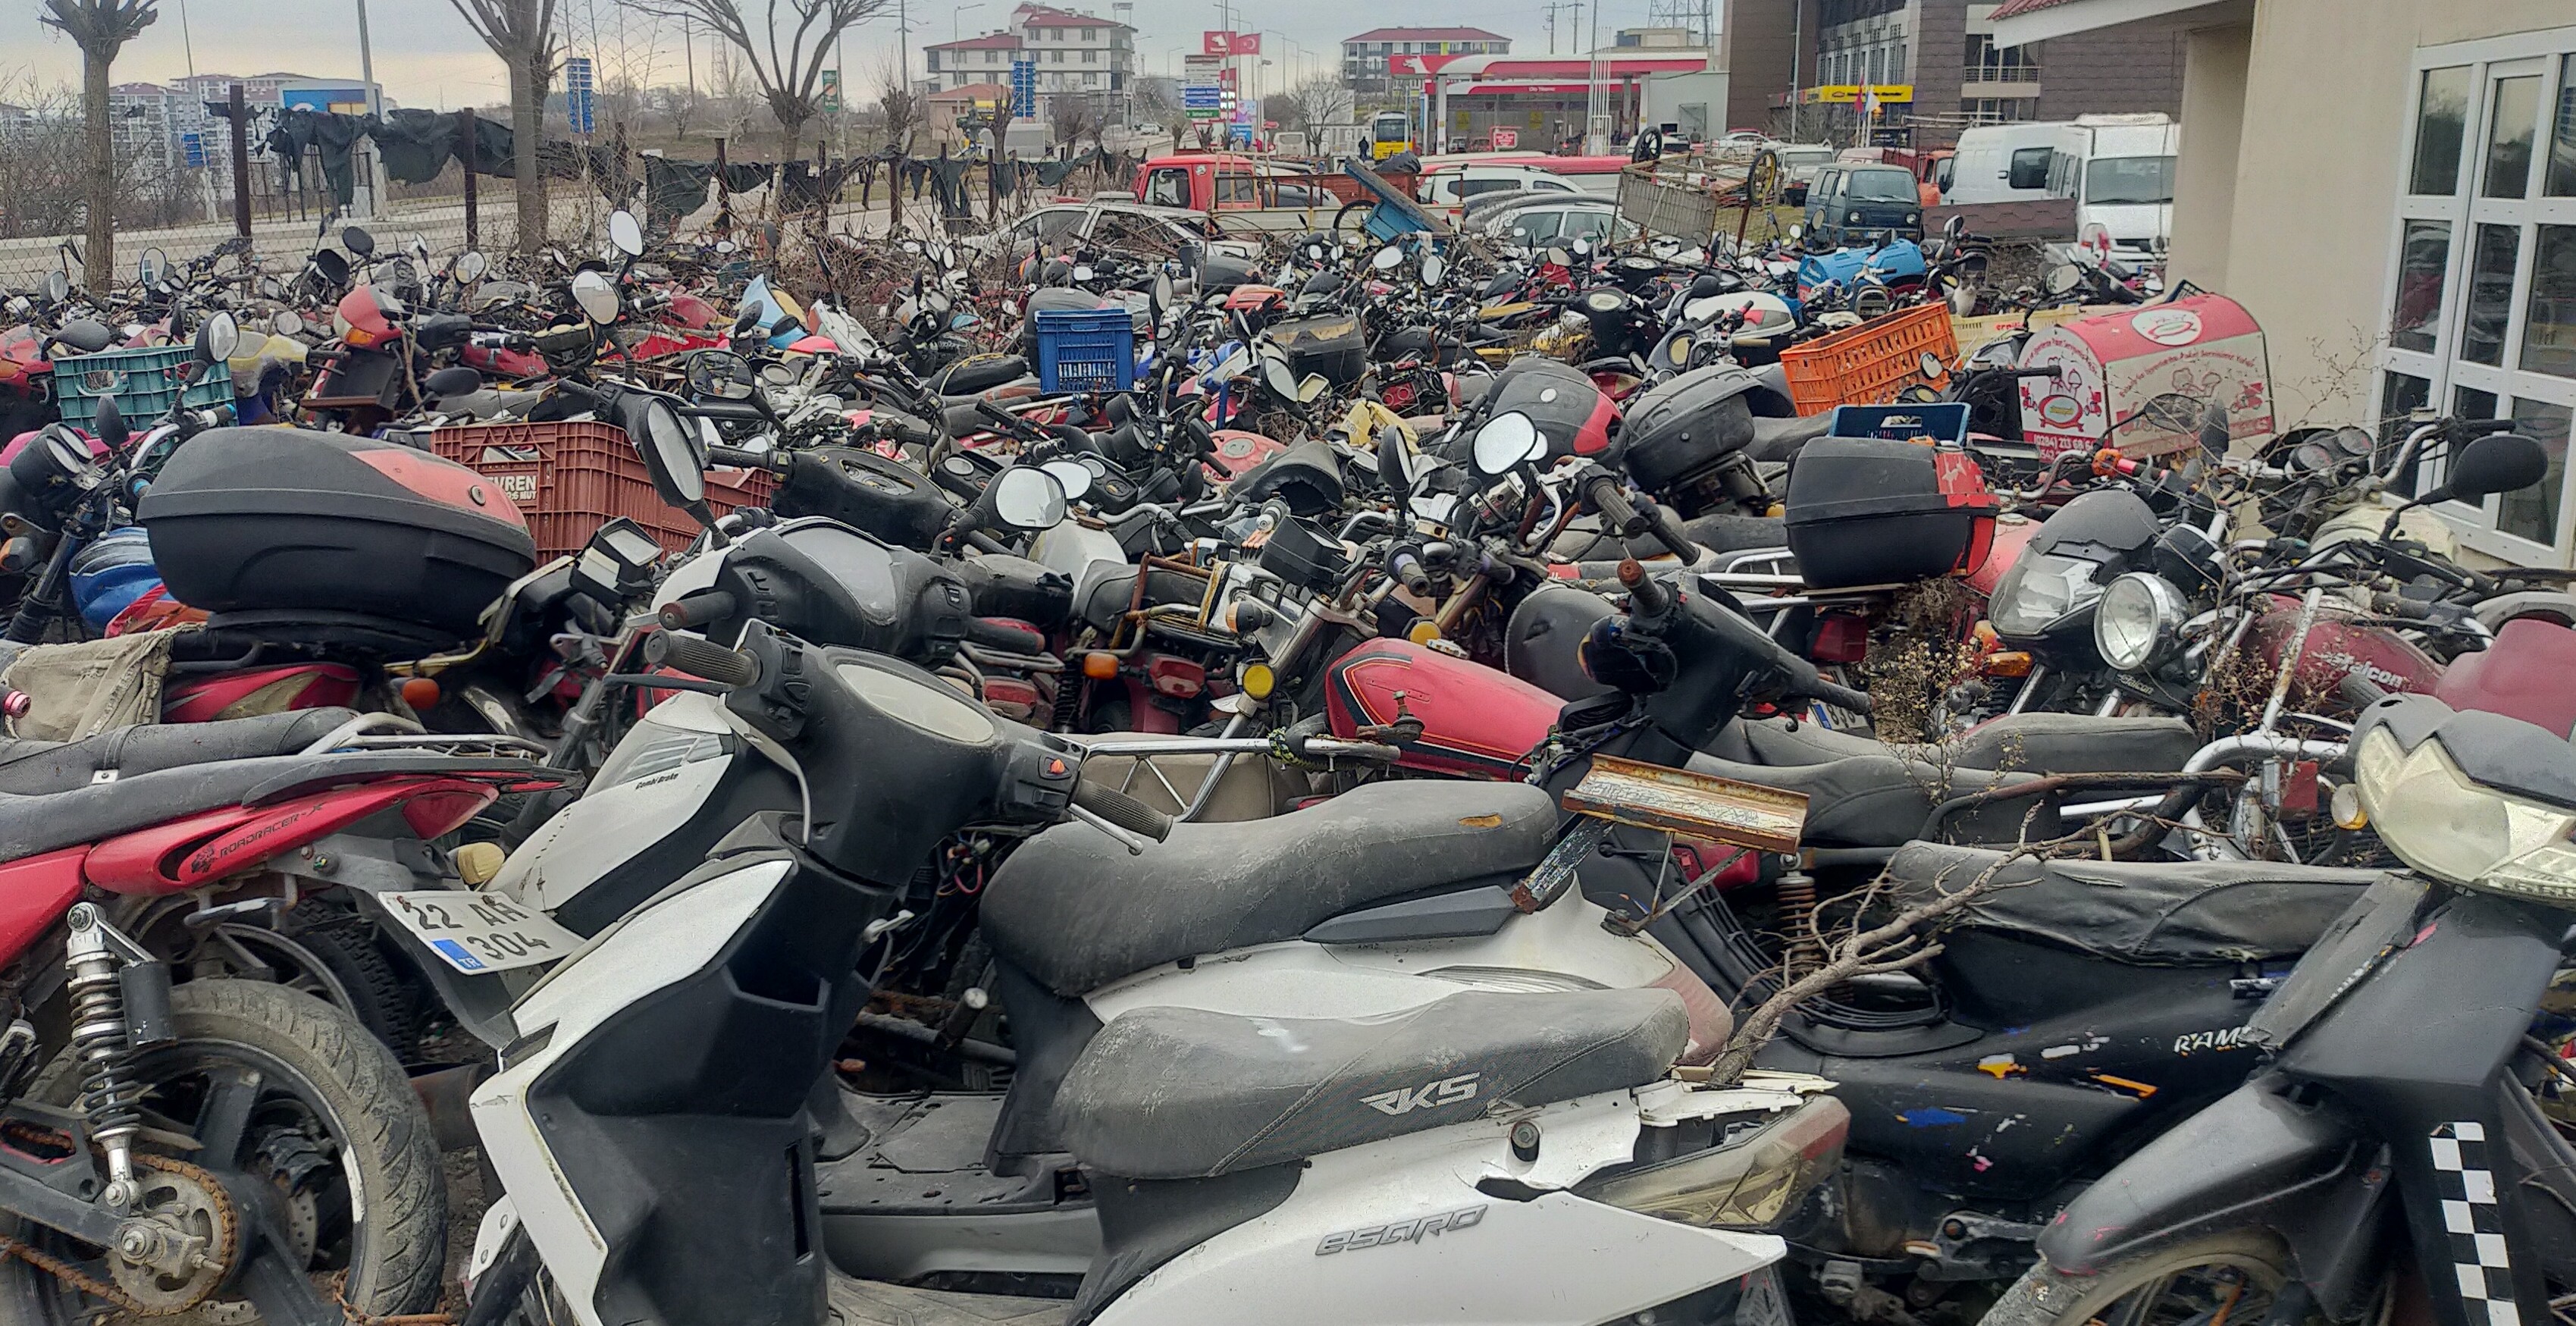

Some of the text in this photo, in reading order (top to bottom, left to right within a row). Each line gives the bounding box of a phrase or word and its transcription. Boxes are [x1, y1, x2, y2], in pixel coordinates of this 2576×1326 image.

[520, 491, 537, 500] MUT
[403, 902, 530, 930] 22 AH
[466, 932, 551, 960] 304
[457, 957, 481, 969] TR
[1359, 1071, 1481, 1116] RKS
